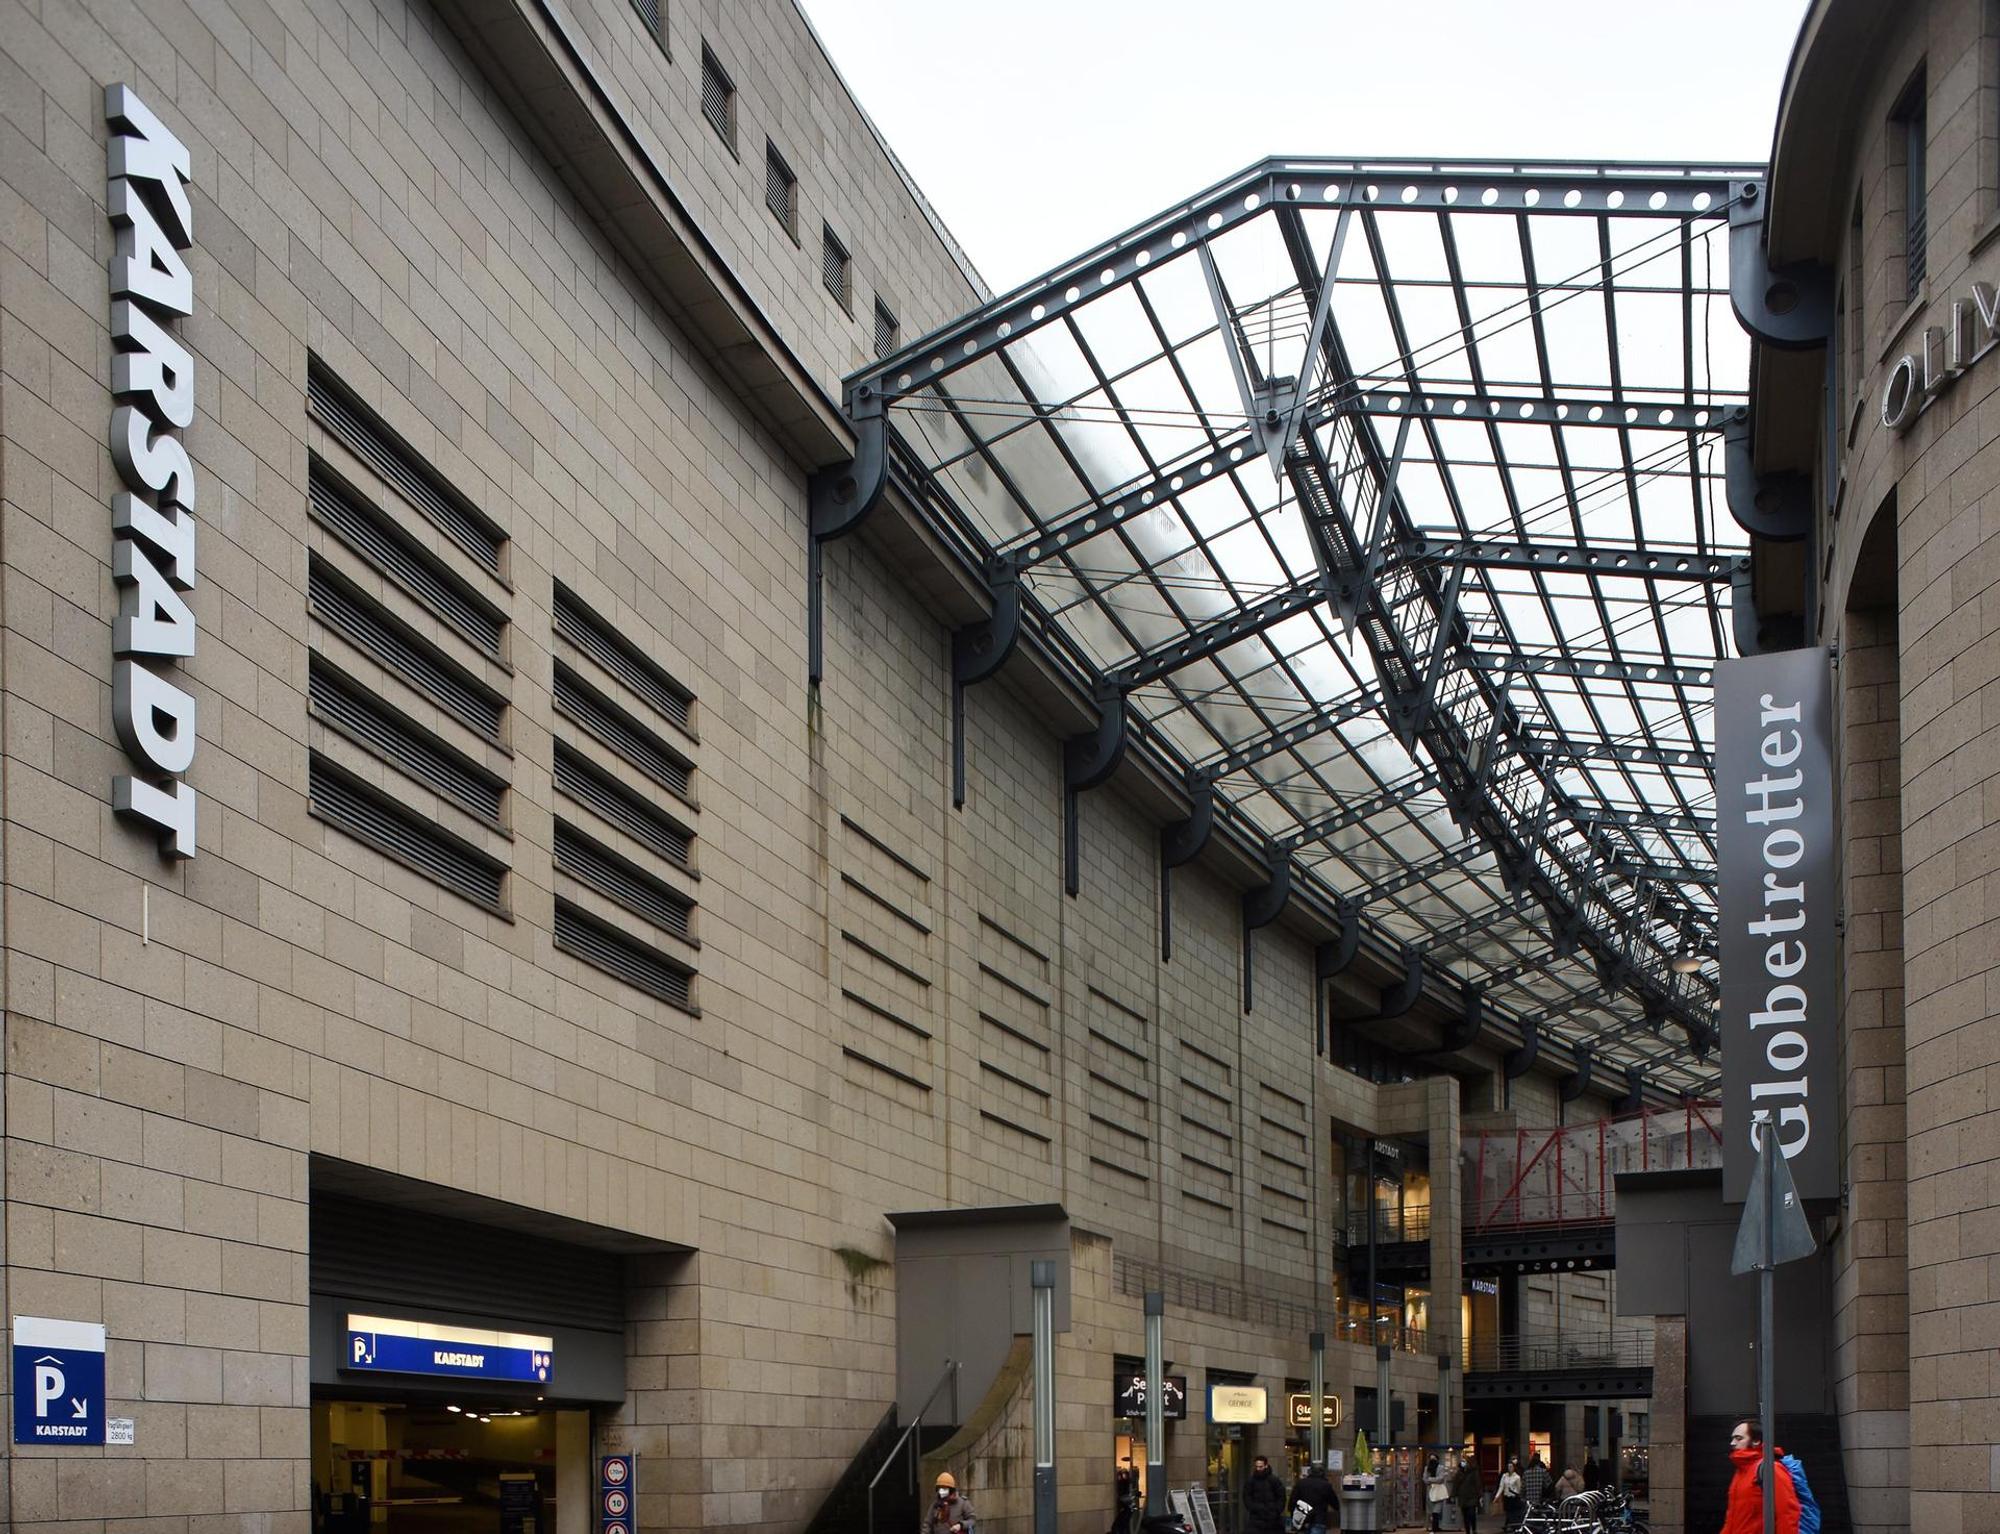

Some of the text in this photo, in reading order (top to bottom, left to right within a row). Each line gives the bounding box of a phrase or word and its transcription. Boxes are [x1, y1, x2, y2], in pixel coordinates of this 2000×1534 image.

[106, 82, 197, 859] KARSTADT
[1745, 693, 1811, 1160] Globetrotter
[353, 1340, 365, 1362] P
[434, 1351, 484, 1368] KARSTADT
[35, 1365, 65, 1417] P
[36, 1425, 87, 1436] KARSTADT
[111, 1431, 126, 1440] 2800
